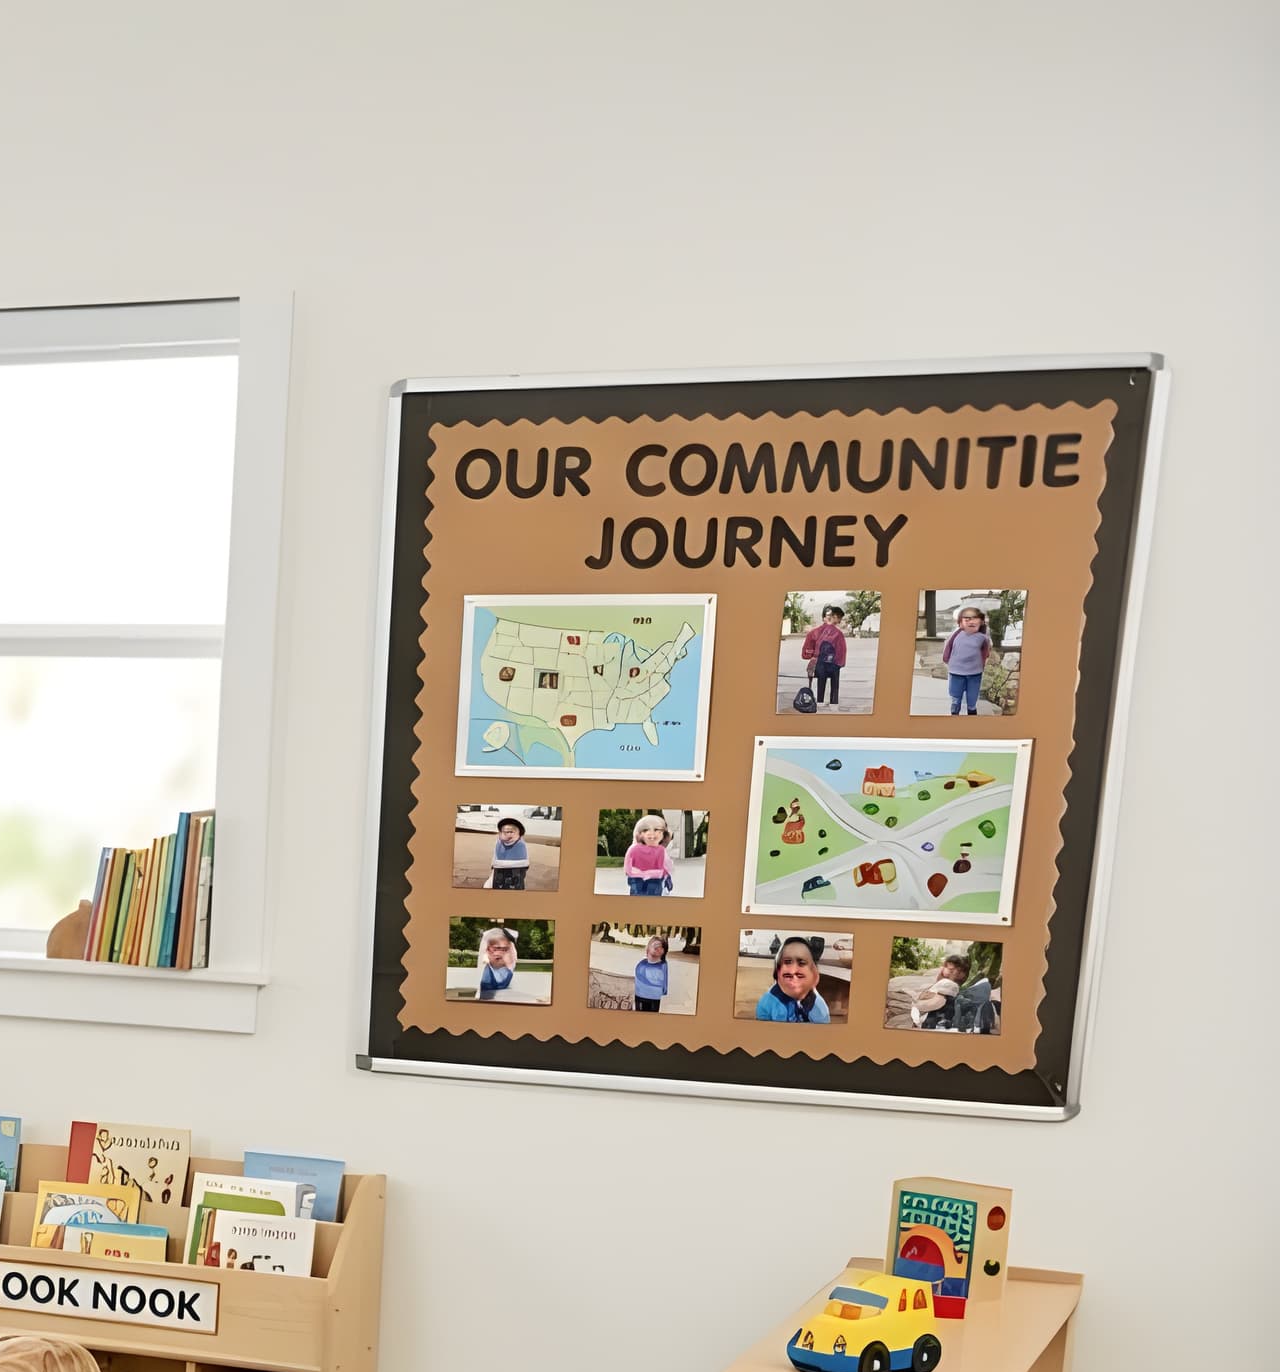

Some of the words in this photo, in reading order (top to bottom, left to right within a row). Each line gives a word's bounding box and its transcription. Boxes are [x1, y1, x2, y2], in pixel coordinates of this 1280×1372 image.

[455, 446, 592, 500] OUR
[625, 432, 1082, 497] COMMUNITIE
[585, 514, 908, 570] JOURNEY
[92, 1281, 201, 1322] NOOK
